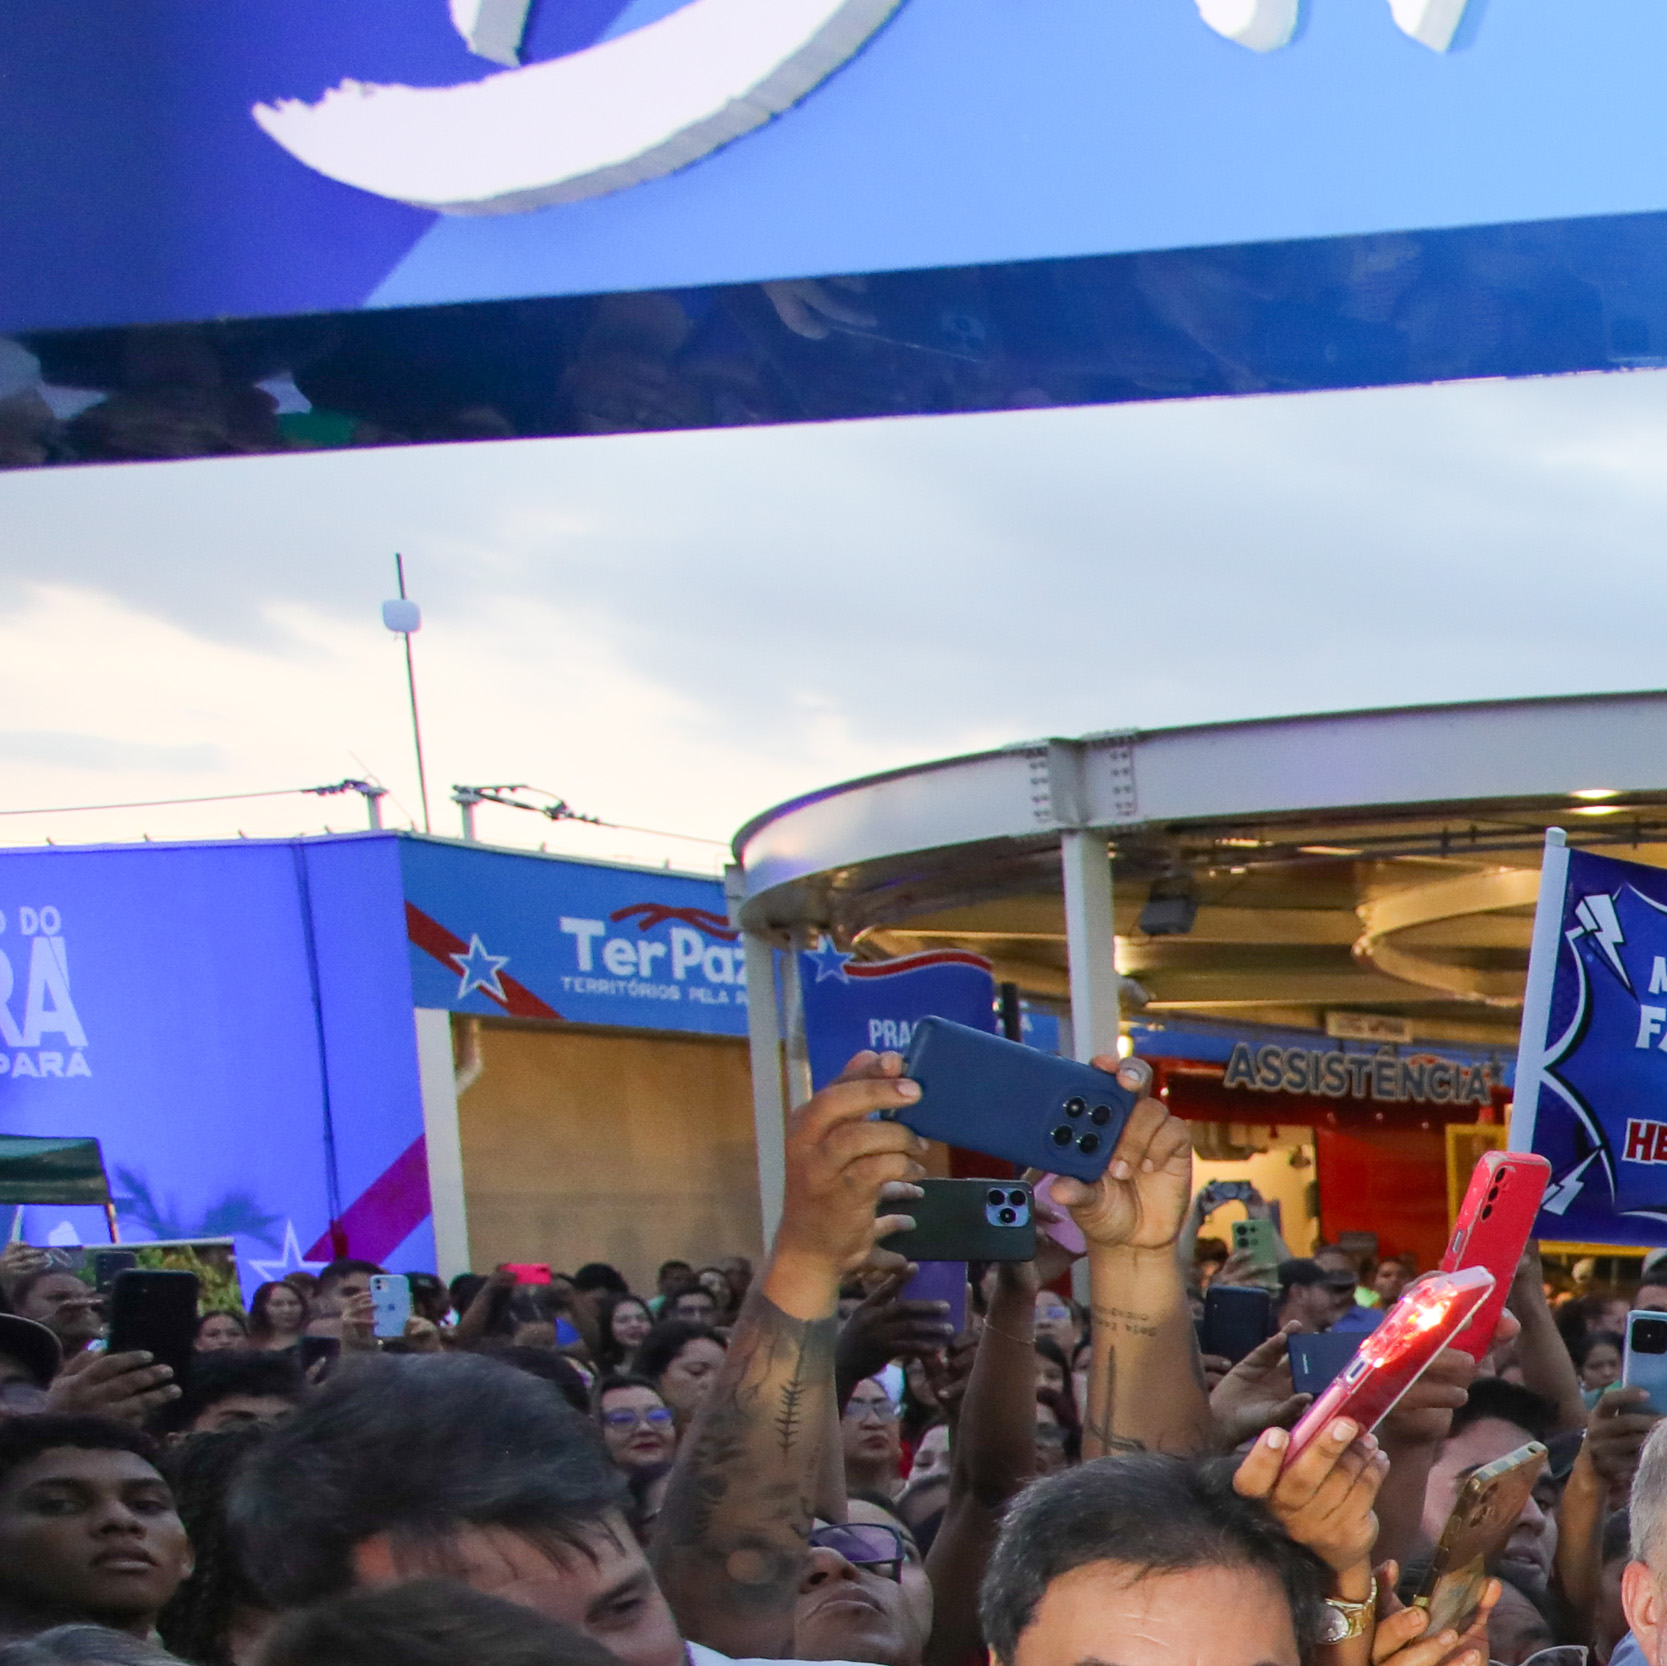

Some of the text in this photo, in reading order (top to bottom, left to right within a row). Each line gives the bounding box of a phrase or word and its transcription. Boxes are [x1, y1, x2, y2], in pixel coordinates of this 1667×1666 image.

[19, 905, 61, 936] DO
[868, 1018, 918, 1048] PRA
[1223, 1042, 1492, 1105] ASSISTÊNCIA
